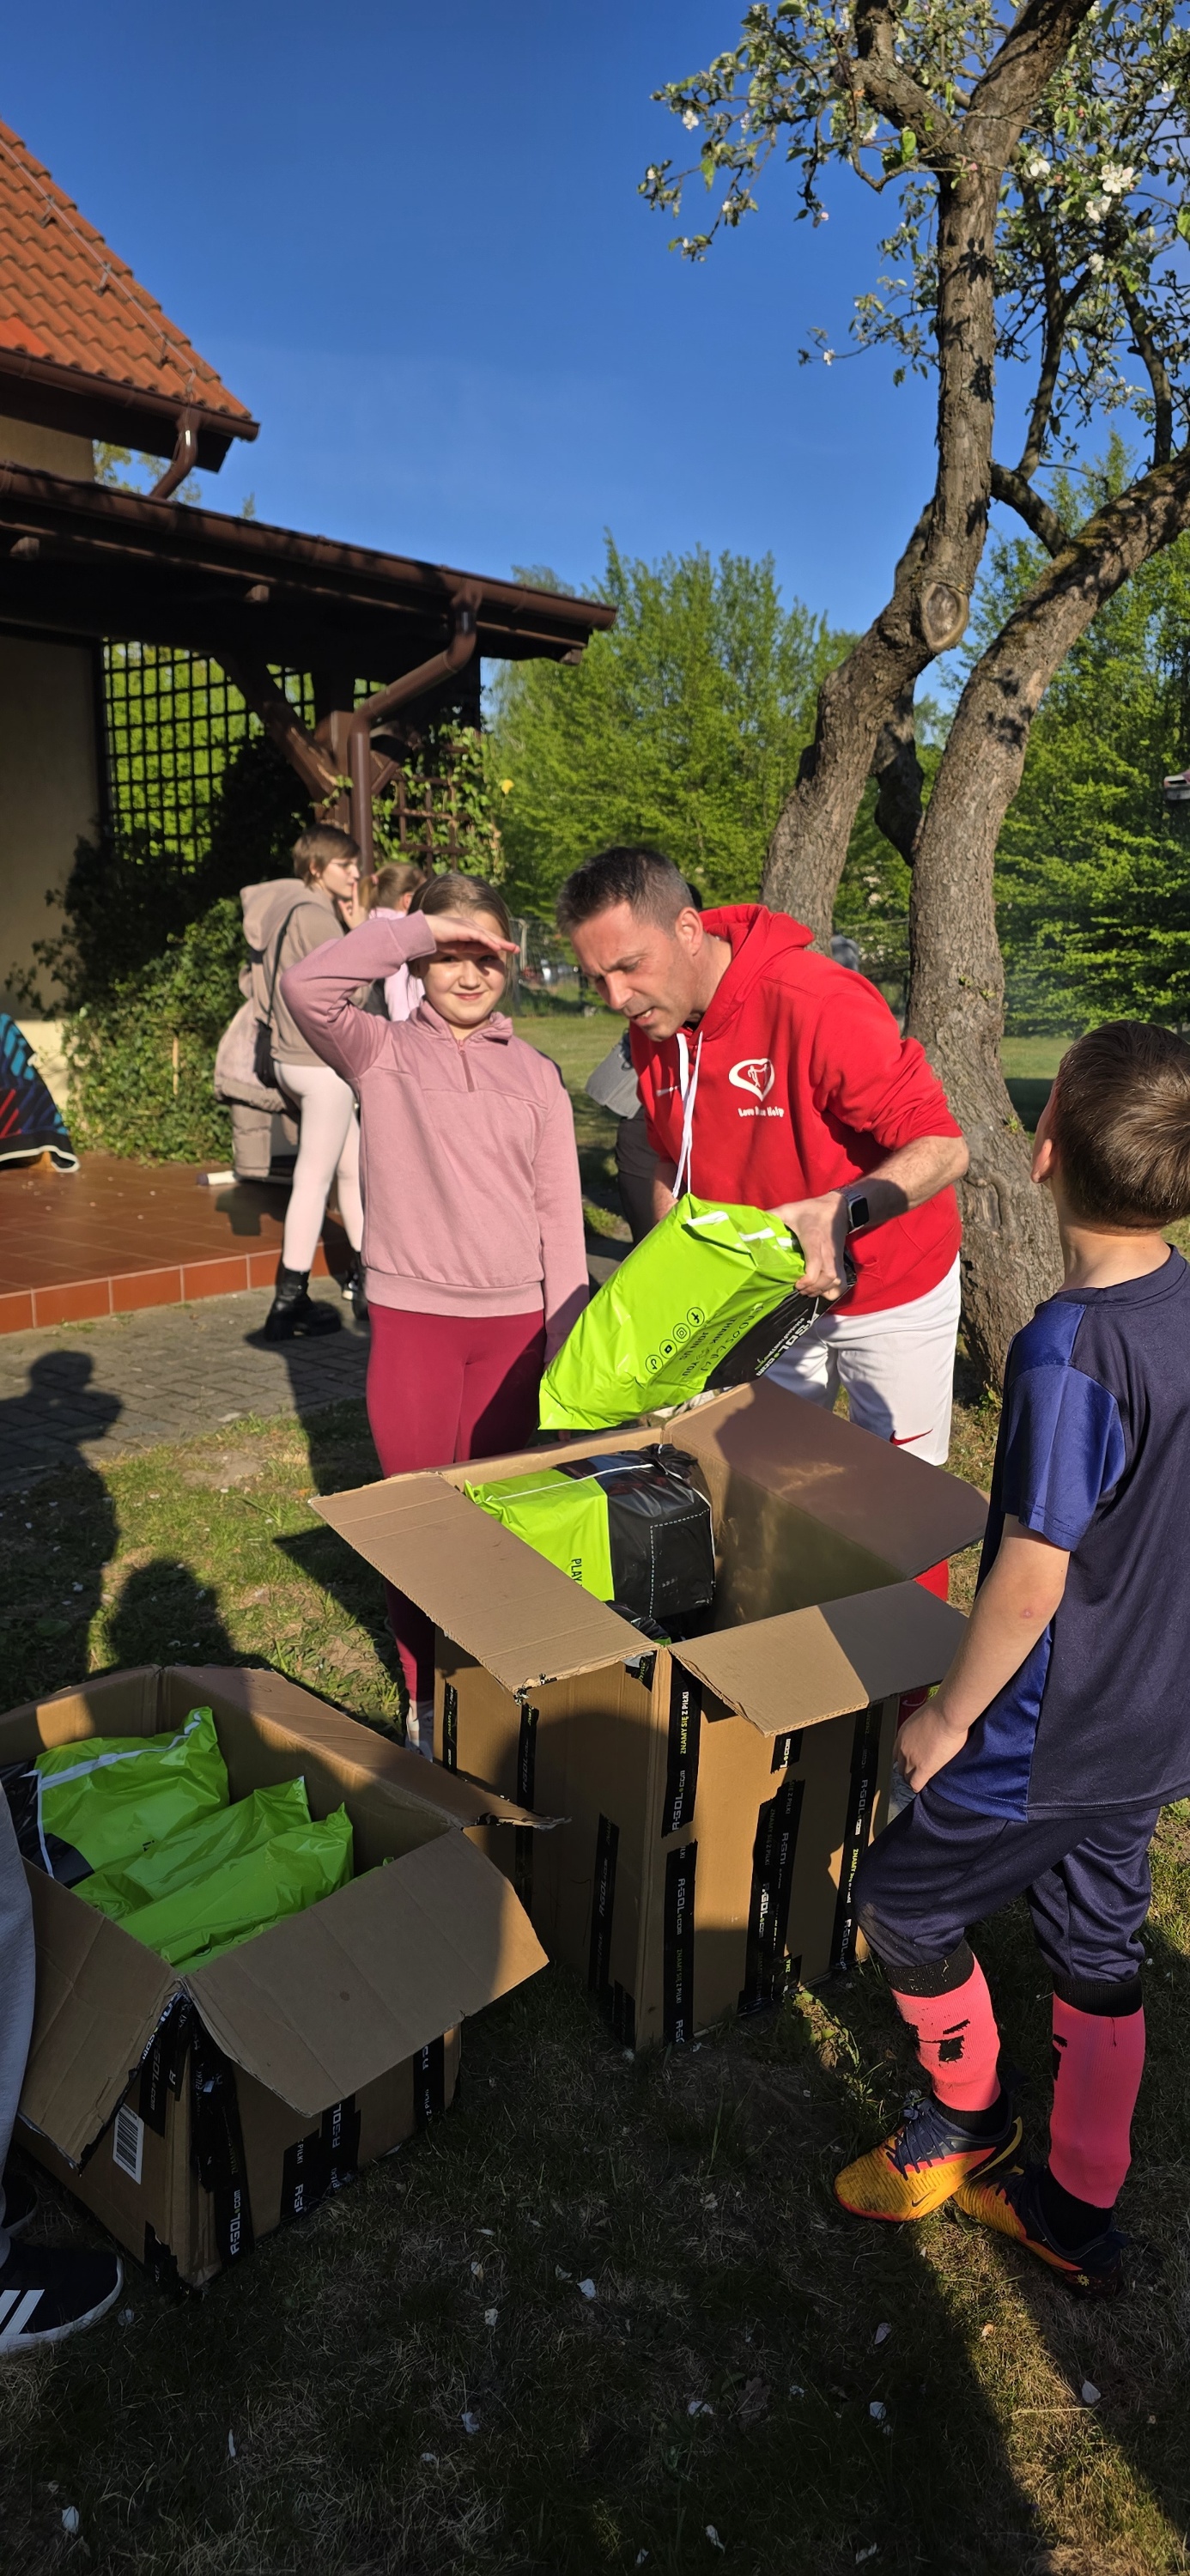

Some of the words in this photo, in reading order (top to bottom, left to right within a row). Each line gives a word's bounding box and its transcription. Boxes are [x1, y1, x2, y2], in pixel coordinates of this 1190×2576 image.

[767, 1106, 785, 1118] Help
[690, 1330, 709, 1350] JOIN
[709, 1315, 736, 1346] THANK
[681, 1358, 698, 1378] YOU
[571, 1558, 582, 1581] PLAY
[851, 1847, 859, 1872] ZNAMY
